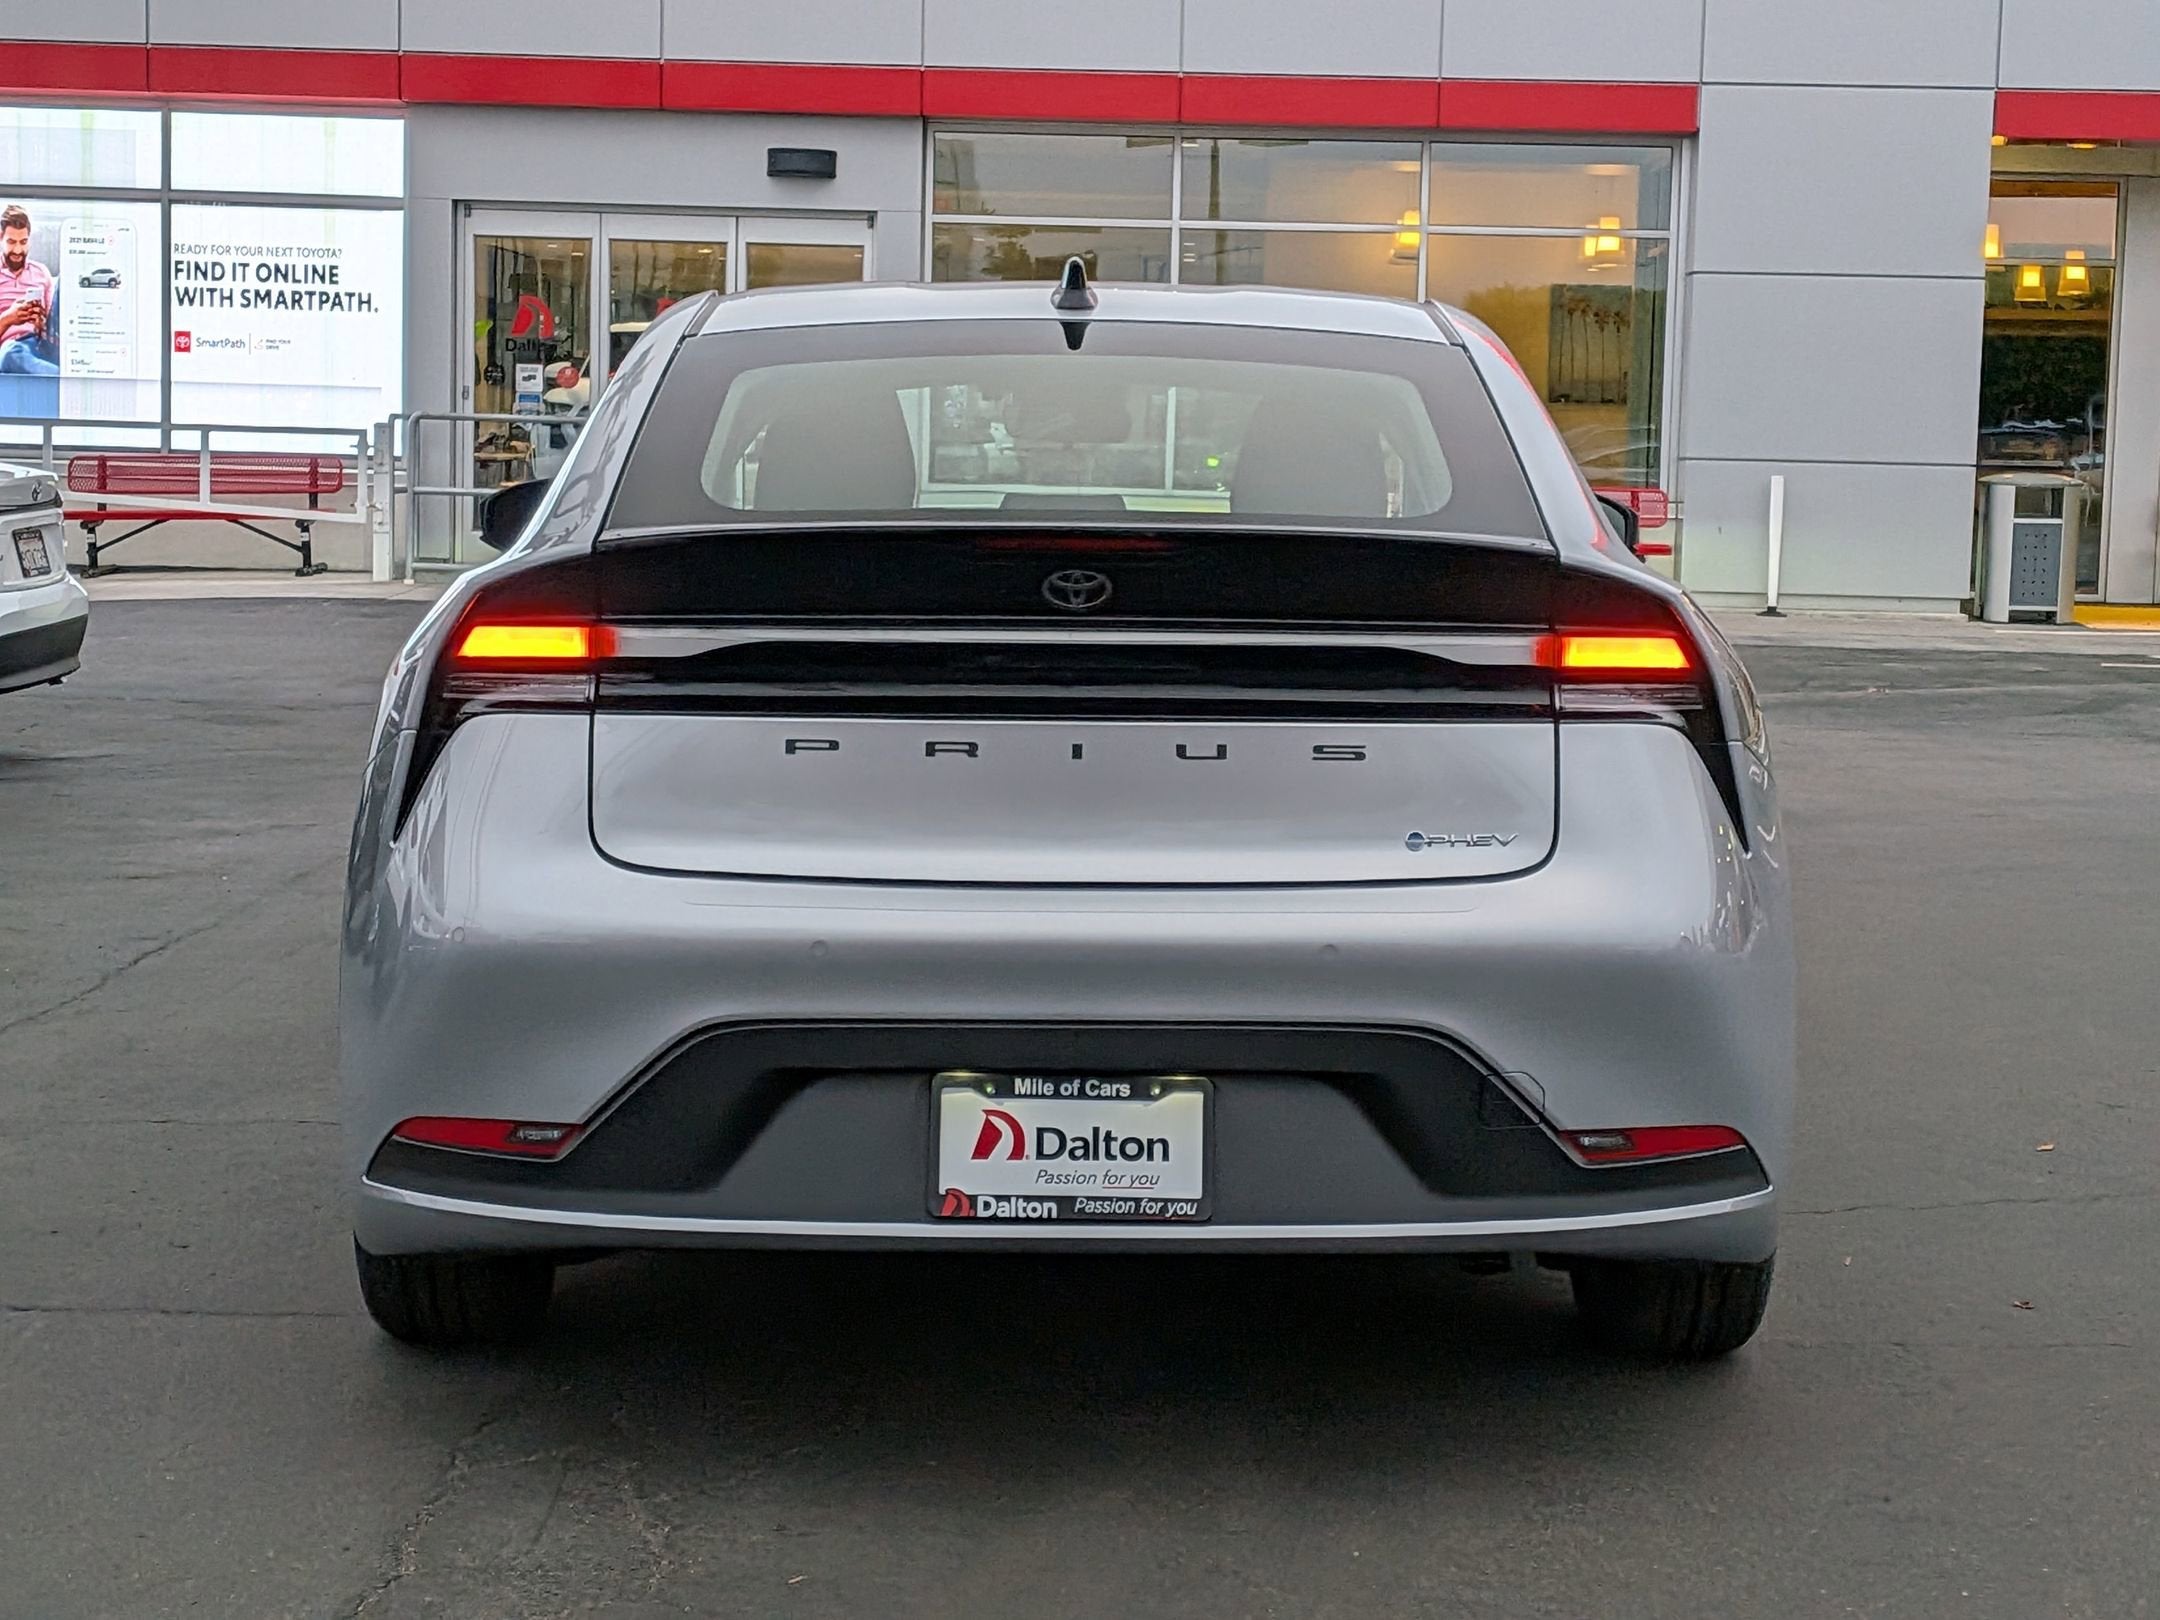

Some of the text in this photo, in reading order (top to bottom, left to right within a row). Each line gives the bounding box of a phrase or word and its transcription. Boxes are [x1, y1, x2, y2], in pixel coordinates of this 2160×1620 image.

[173, 243, 342, 259] READY FOR YOUR NEXT TOYOTA?
[174, 260, 340, 285] FIND IT ONLINE
[175, 286, 379, 314] WITH SMARTPATH.
[196, 336, 246, 349] SmartPath
[784, 738, 1368, 762] PRIUS
[1424, 832, 1519, 848] PHEV
[1013, 1077, 1131, 1098] Mile of Cars
[1035, 1126, 1170, 1162] Dalton
[1035, 1169, 1160, 1189] Passion for you
[976, 1194, 1198, 1219] Dalton Passion for you
